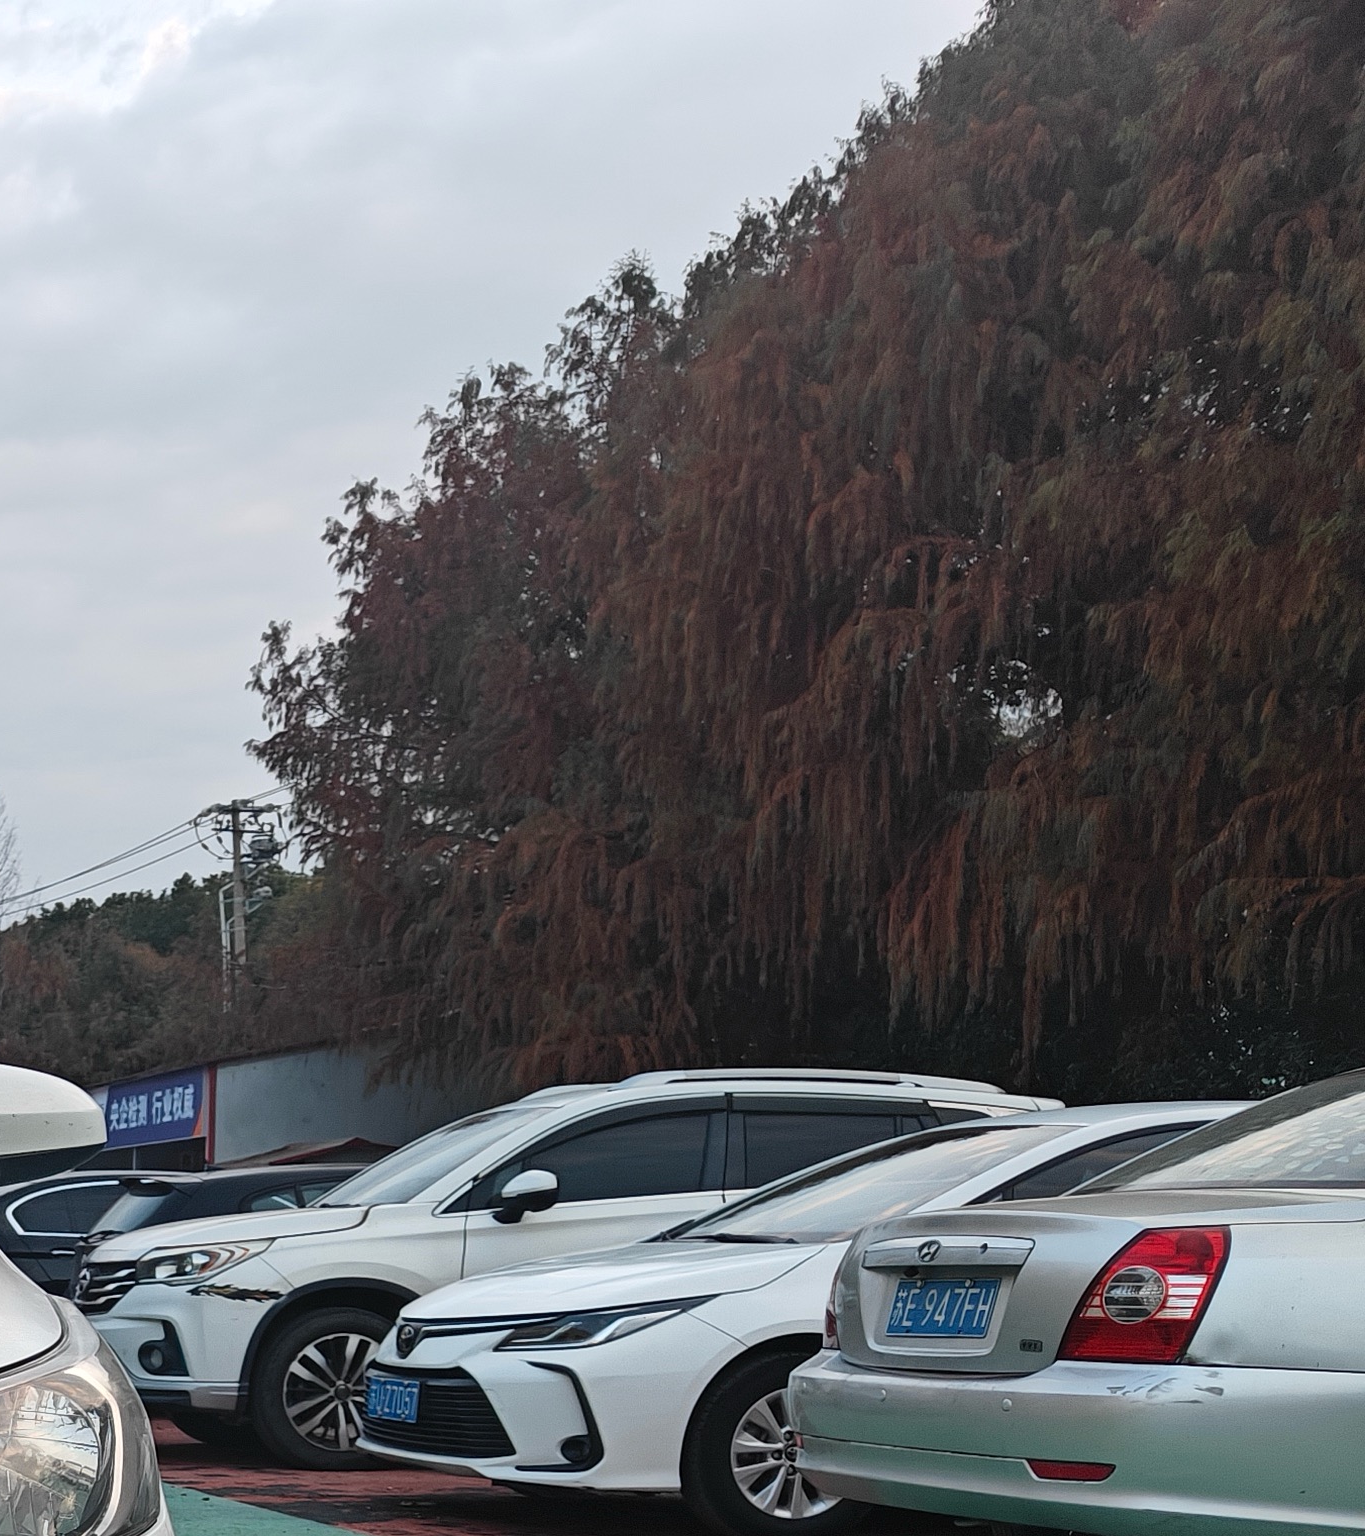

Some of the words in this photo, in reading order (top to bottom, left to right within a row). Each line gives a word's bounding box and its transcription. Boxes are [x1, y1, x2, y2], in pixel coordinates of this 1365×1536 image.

[110, 1093, 148, 1132] 央企检测
[152, 1083, 195, 1125] 行业权威
